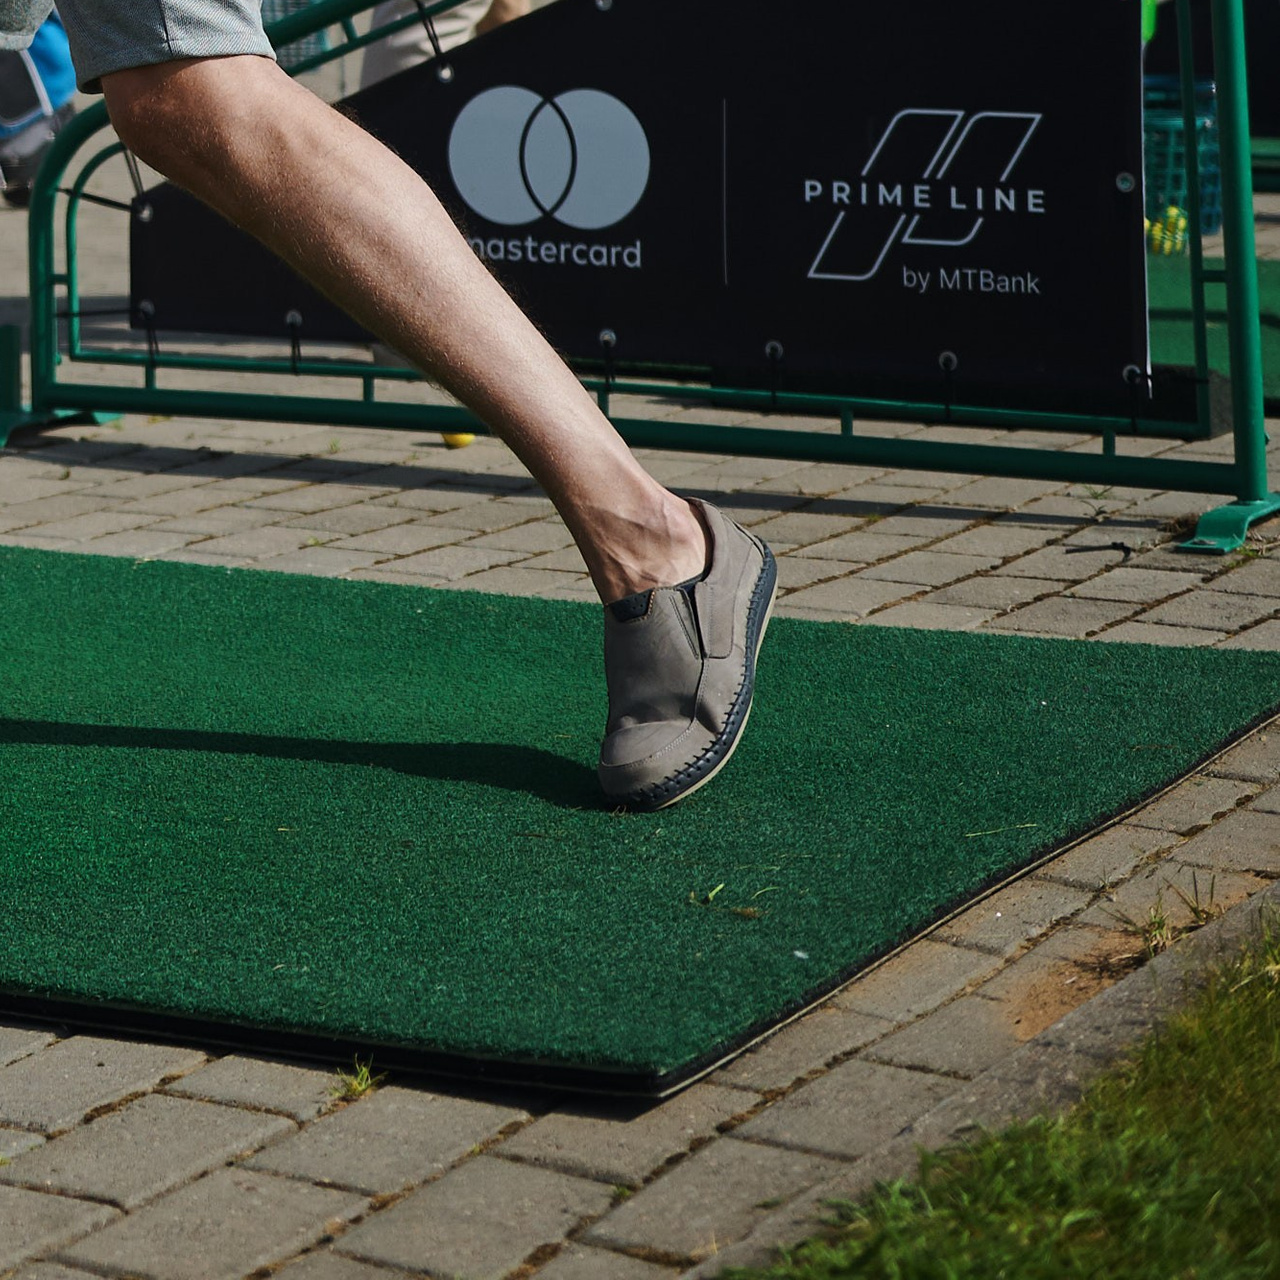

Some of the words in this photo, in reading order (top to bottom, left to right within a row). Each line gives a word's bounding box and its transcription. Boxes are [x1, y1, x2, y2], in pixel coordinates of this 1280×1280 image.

[804, 179, 932, 209] PRIME
[949, 185, 1046, 214] LINE
[903, 266, 930, 294] by
[939, 268, 1041, 294] MTBank
